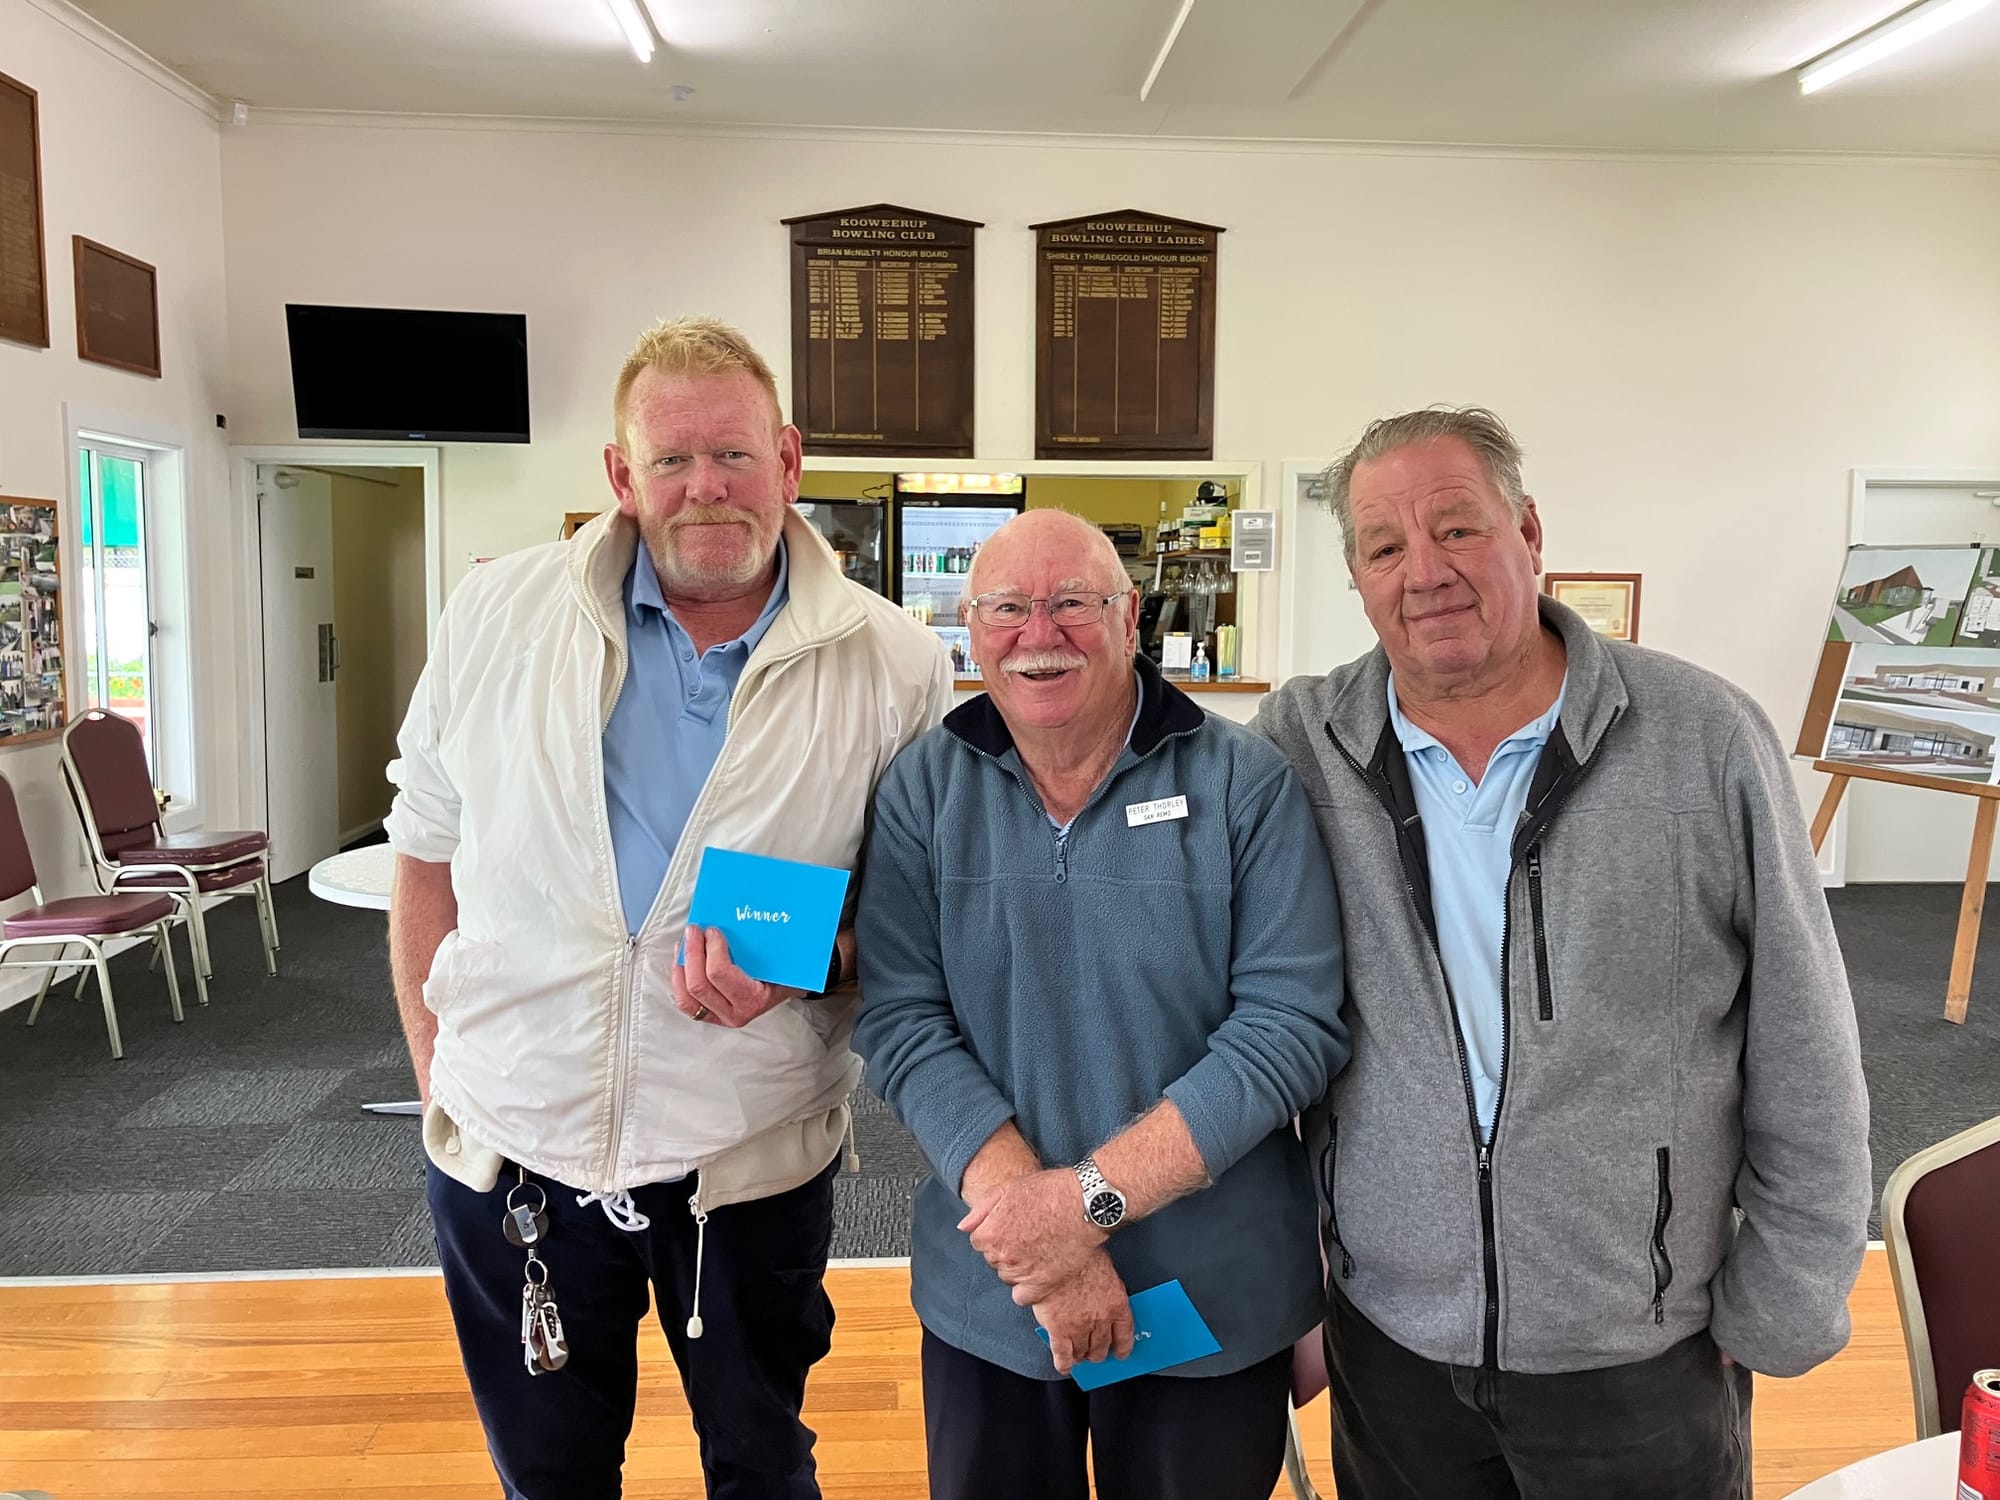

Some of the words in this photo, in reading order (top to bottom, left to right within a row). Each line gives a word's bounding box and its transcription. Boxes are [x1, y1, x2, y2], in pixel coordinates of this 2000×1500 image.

[840, 218, 927, 228] KOOWEERUP
[1087, 223, 1172, 233] KOOWEERUP
[832, 229, 896, 239] BOWLING
[900, 231, 936, 240] CLUB
[1051, 234, 1114, 243] BOWLING
[1119, 235, 1153, 244] CLUB
[1157, 236, 1206, 245] LADIES
[817, 248, 842, 256] BRIAN
[883, 250, 918, 258] HONOUR
[1046, 252, 1081, 261] SHIRLEY
[1084, 253, 1140, 262] THREADGOLD
[1142, 255, 1178, 263] HONOUR
[1128, 805, 1150, 815] PETER
[1153, 799, 1184, 810] THORLEY
[736, 905, 791, 923] Winner
